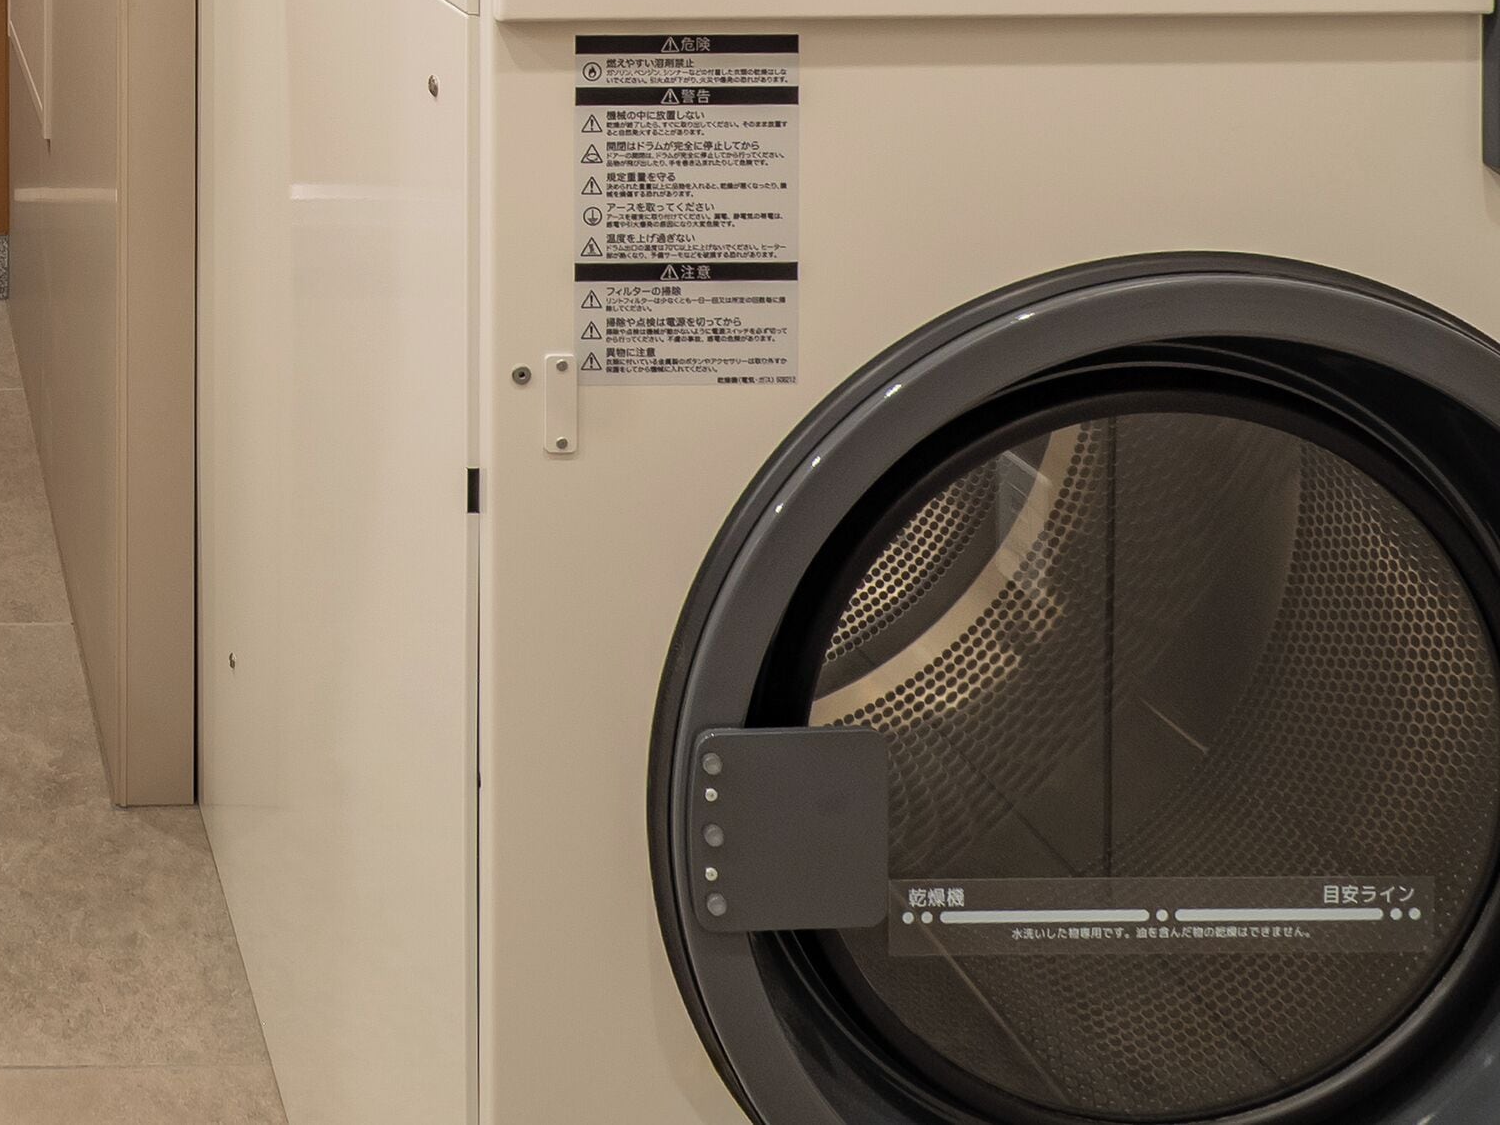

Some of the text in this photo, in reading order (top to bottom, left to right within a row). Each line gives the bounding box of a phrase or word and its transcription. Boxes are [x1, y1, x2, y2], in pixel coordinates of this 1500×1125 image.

[681, 37, 710, 52] 危険
[606, 58, 694, 68] 燃えやすい溶剤禁止
[681, 89, 711, 104] 警告
[606, 111, 704, 120] 機械の中に放置しない
[606, 141, 759, 151] 開閉はドラムが完全に停止してから
[606, 172, 676, 182] 規定重量を守る
[607, 203, 715, 212] アースを取ってください
[606, 233, 695, 243] 温度を上げ過ぎない
[681, 264, 711, 280] 注意
[606, 286, 682, 296] フィルターの掃除
[606, 317, 742, 327] 掃除や点検は電源を切ってから
[606, 348, 656, 358] 異物に注意
[908, 884, 1415, 908] 乾燥機 目安ライン
